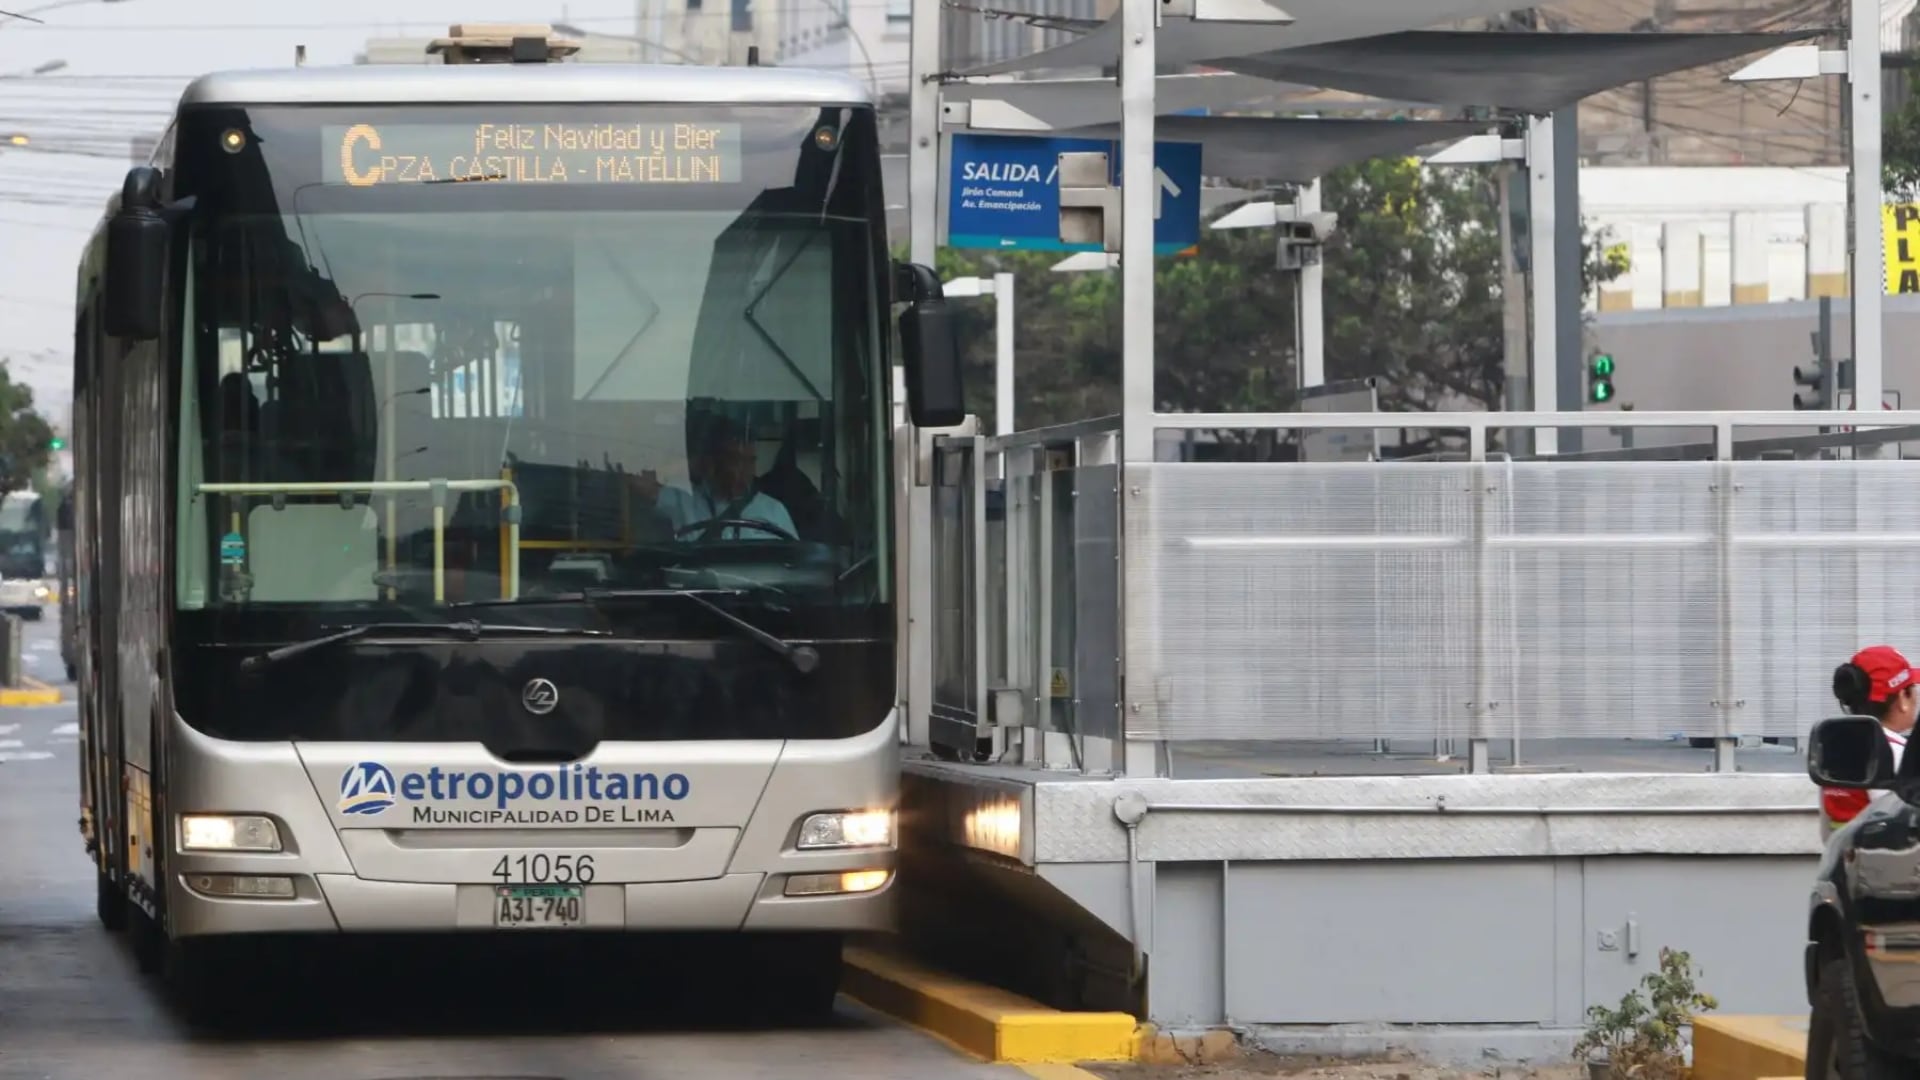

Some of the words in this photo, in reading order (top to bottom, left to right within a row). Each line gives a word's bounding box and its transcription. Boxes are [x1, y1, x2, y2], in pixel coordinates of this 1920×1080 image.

[544, 123, 641, 150] Navidad
[651, 128, 665, 155] y
[341, 123, 382, 187] C
[450, 155, 568, 183] CASTILLA
[596, 154, 721, 183] MATELLINI
[962, 161, 1040, 182] SALIDA
[413, 805, 579, 824] MUNICIPALIDAD
[621, 804, 675, 823] LIMA
[492, 854, 595, 884] 41056
[500, 897, 579, 922] A31-740
